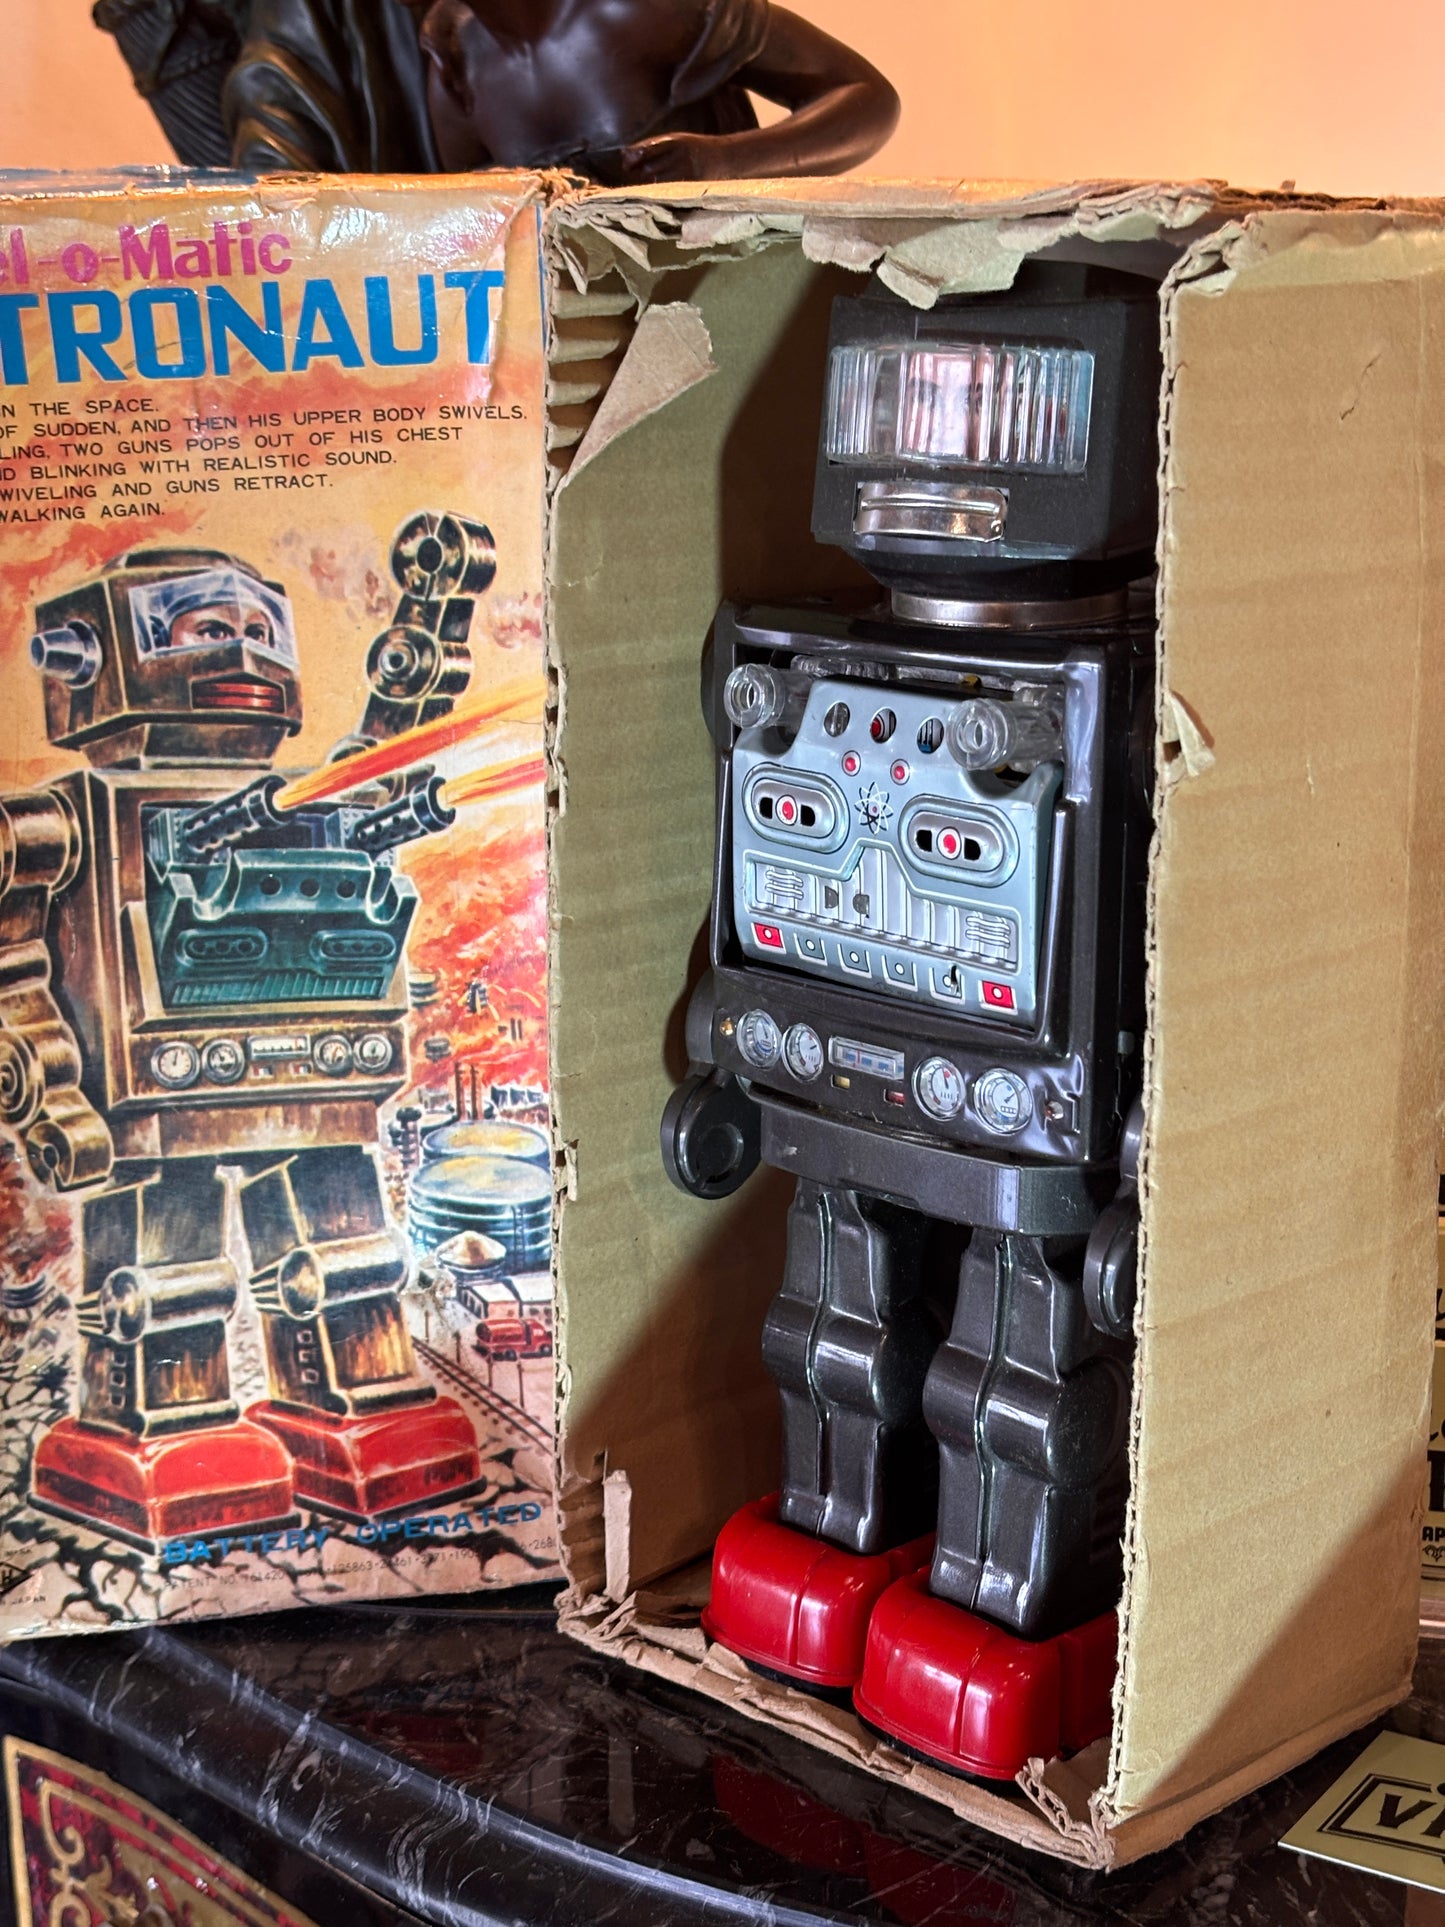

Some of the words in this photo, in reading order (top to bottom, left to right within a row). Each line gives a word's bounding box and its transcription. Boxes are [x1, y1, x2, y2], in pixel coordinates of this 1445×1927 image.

[29, 402, 71, 417] THE
[85, 398, 159, 415] SPACE.
[33, 421, 121, 438] SUDDEN,
[131, 419, 172, 433] AND
[182, 416, 238, 431] THEN
[248, 412, 282, 427] HIS
[293, 409, 361, 426] UPPER
[372, 407, 426, 422] BODY
[439, 405, 528, 420] SWIVELS.
[60, 442, 103, 457] TWO
[118, 439, 172, 455] GUNS
[186, 436, 240, 451] POPS
[254, 433, 294, 448] OUT
[308, 431, 335, 446] OF
[350, 429, 383, 444] HIS
[397, 426, 463, 442] CHEST
[30, 462, 127, 480] BLINKING
[139, 459, 190, 474] WITH
[203, 453, 311, 472] REALISTIC
[325, 450, 397, 466] SOUND.
[112, 481, 152, 497] AND
[166, 478, 220, 494] GUNS
[234, 473, 333, 491] RETRACT.
[100, 502, 164, 519] AGAIN.
[163, 1527, 330, 1565] BATTERY
[356, 1501, 542, 1544] OPERATED
